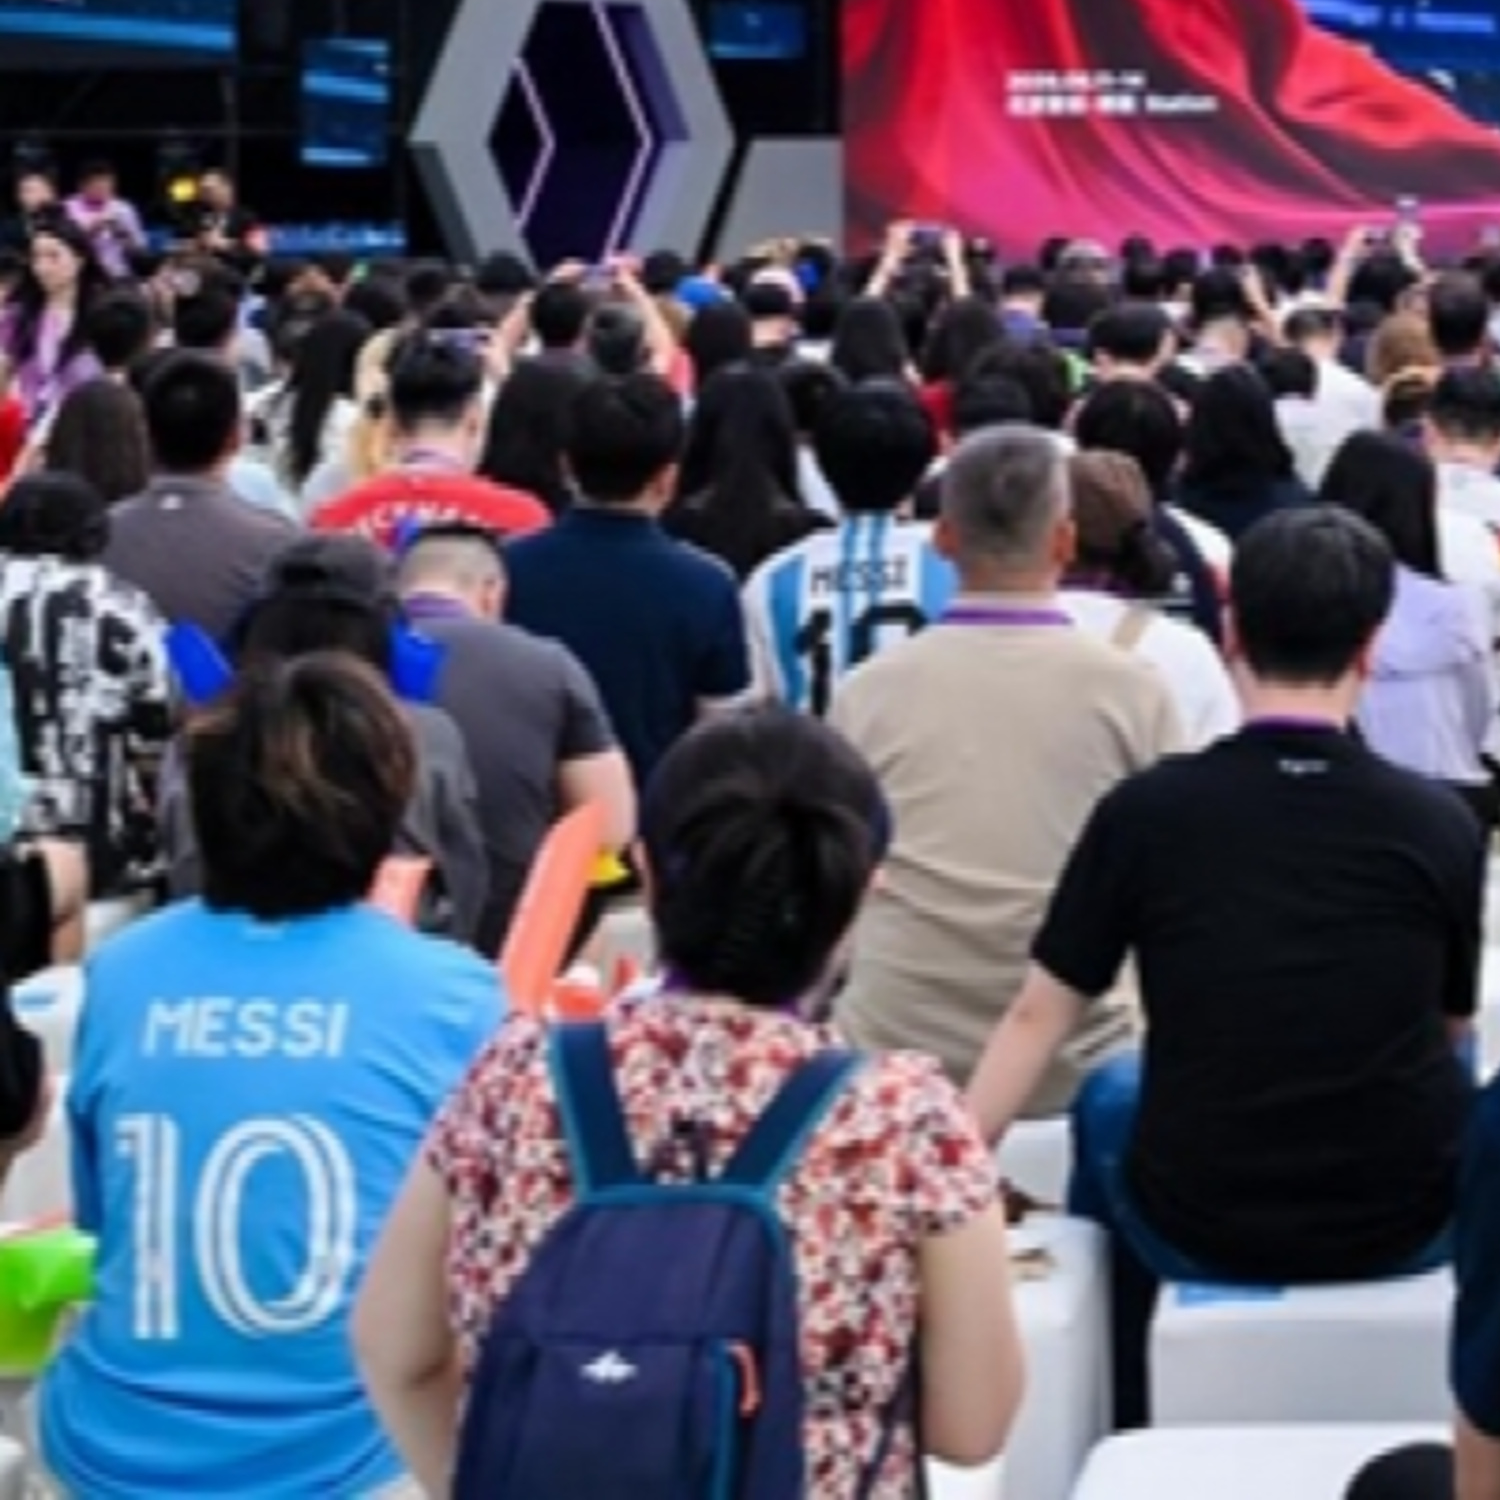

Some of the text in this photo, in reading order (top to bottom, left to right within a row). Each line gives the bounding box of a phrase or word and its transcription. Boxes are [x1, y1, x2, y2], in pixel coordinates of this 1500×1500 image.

[811, 556, 908, 596] MESSI
[143, 997, 350, 1057] MESSI
[113, 1111, 358, 1340] 10
